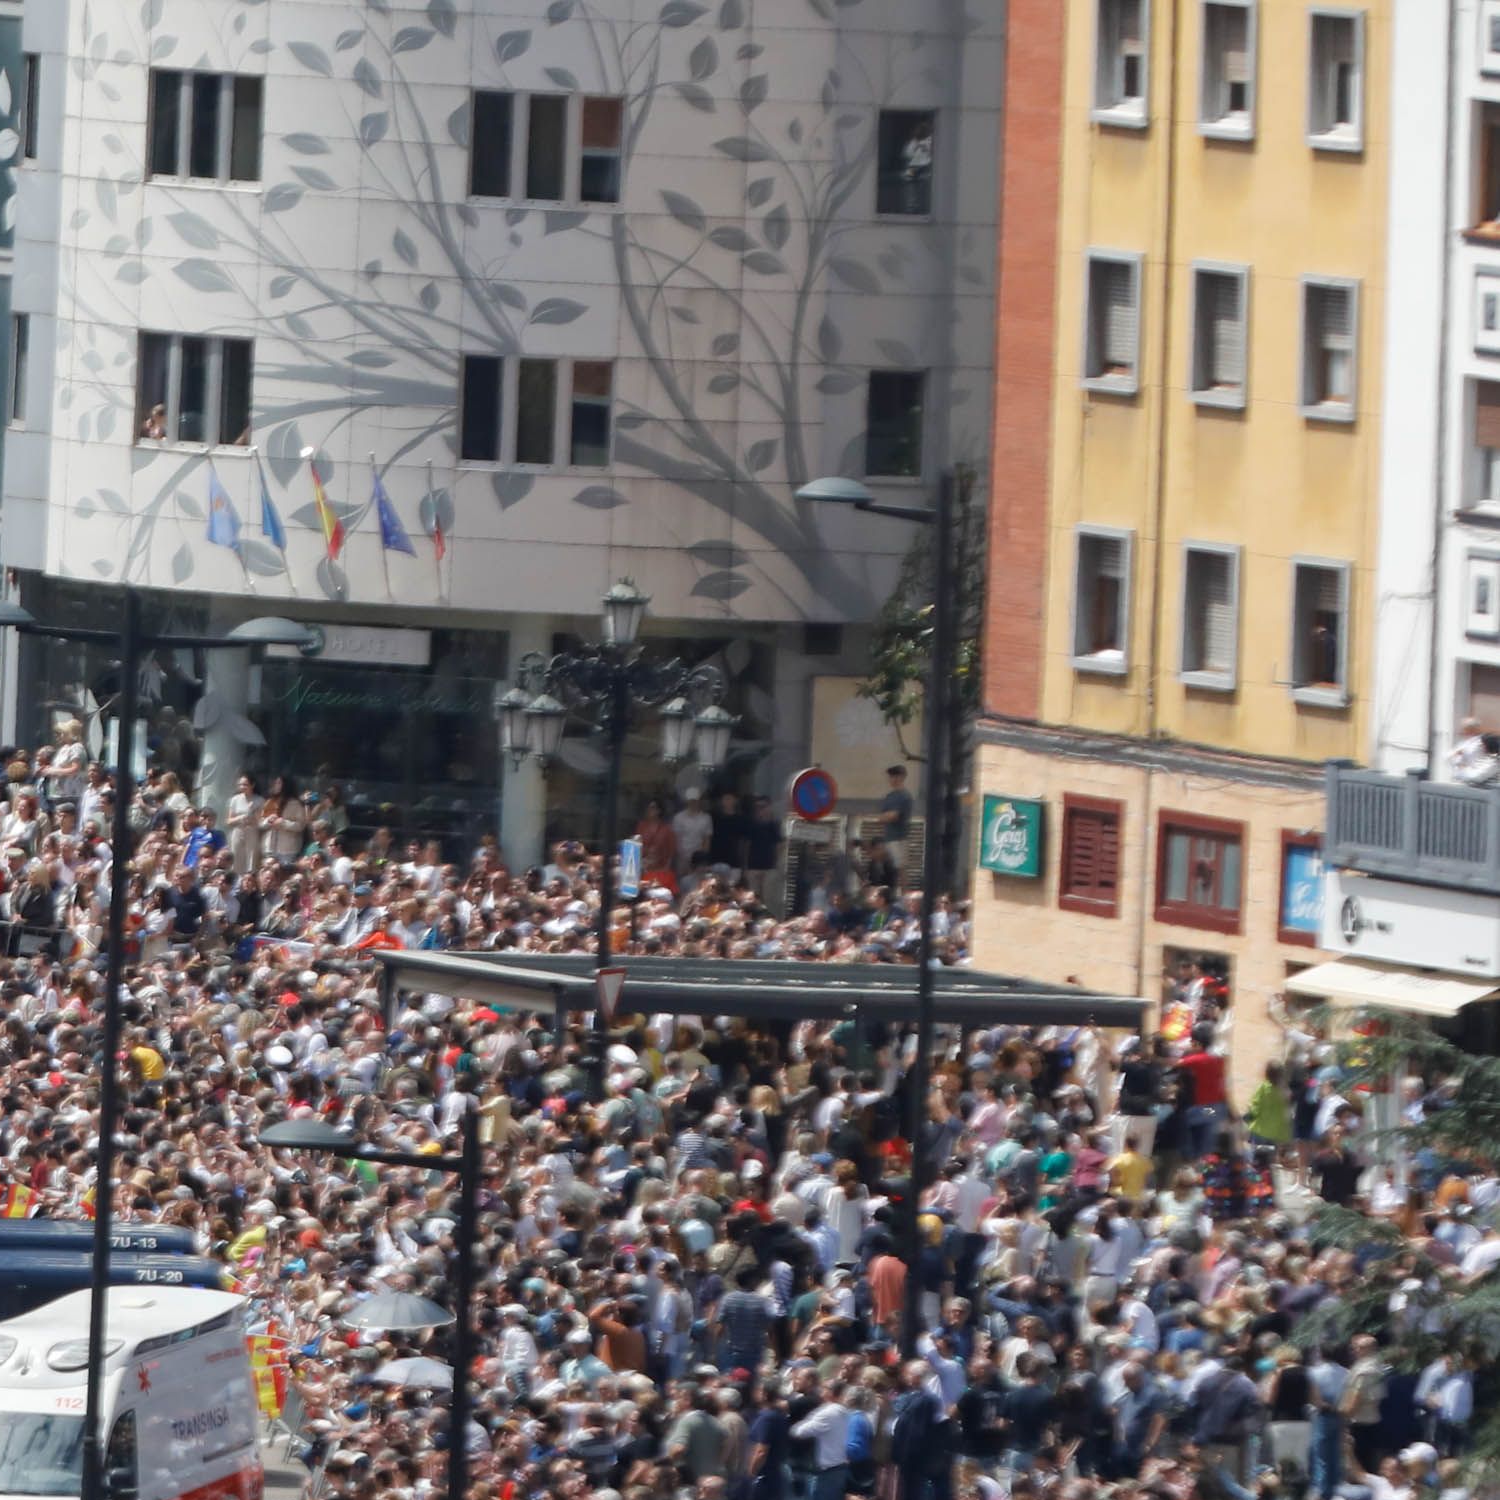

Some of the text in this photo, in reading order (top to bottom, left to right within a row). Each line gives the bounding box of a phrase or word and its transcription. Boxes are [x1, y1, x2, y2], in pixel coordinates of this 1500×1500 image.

[331, 635, 401, 656] HOTEL
[111, 1236, 157, 1249] 7U-13
[55, 1397, 84, 1409] 112
[171, 1405, 230, 1439] TRANSINSA
